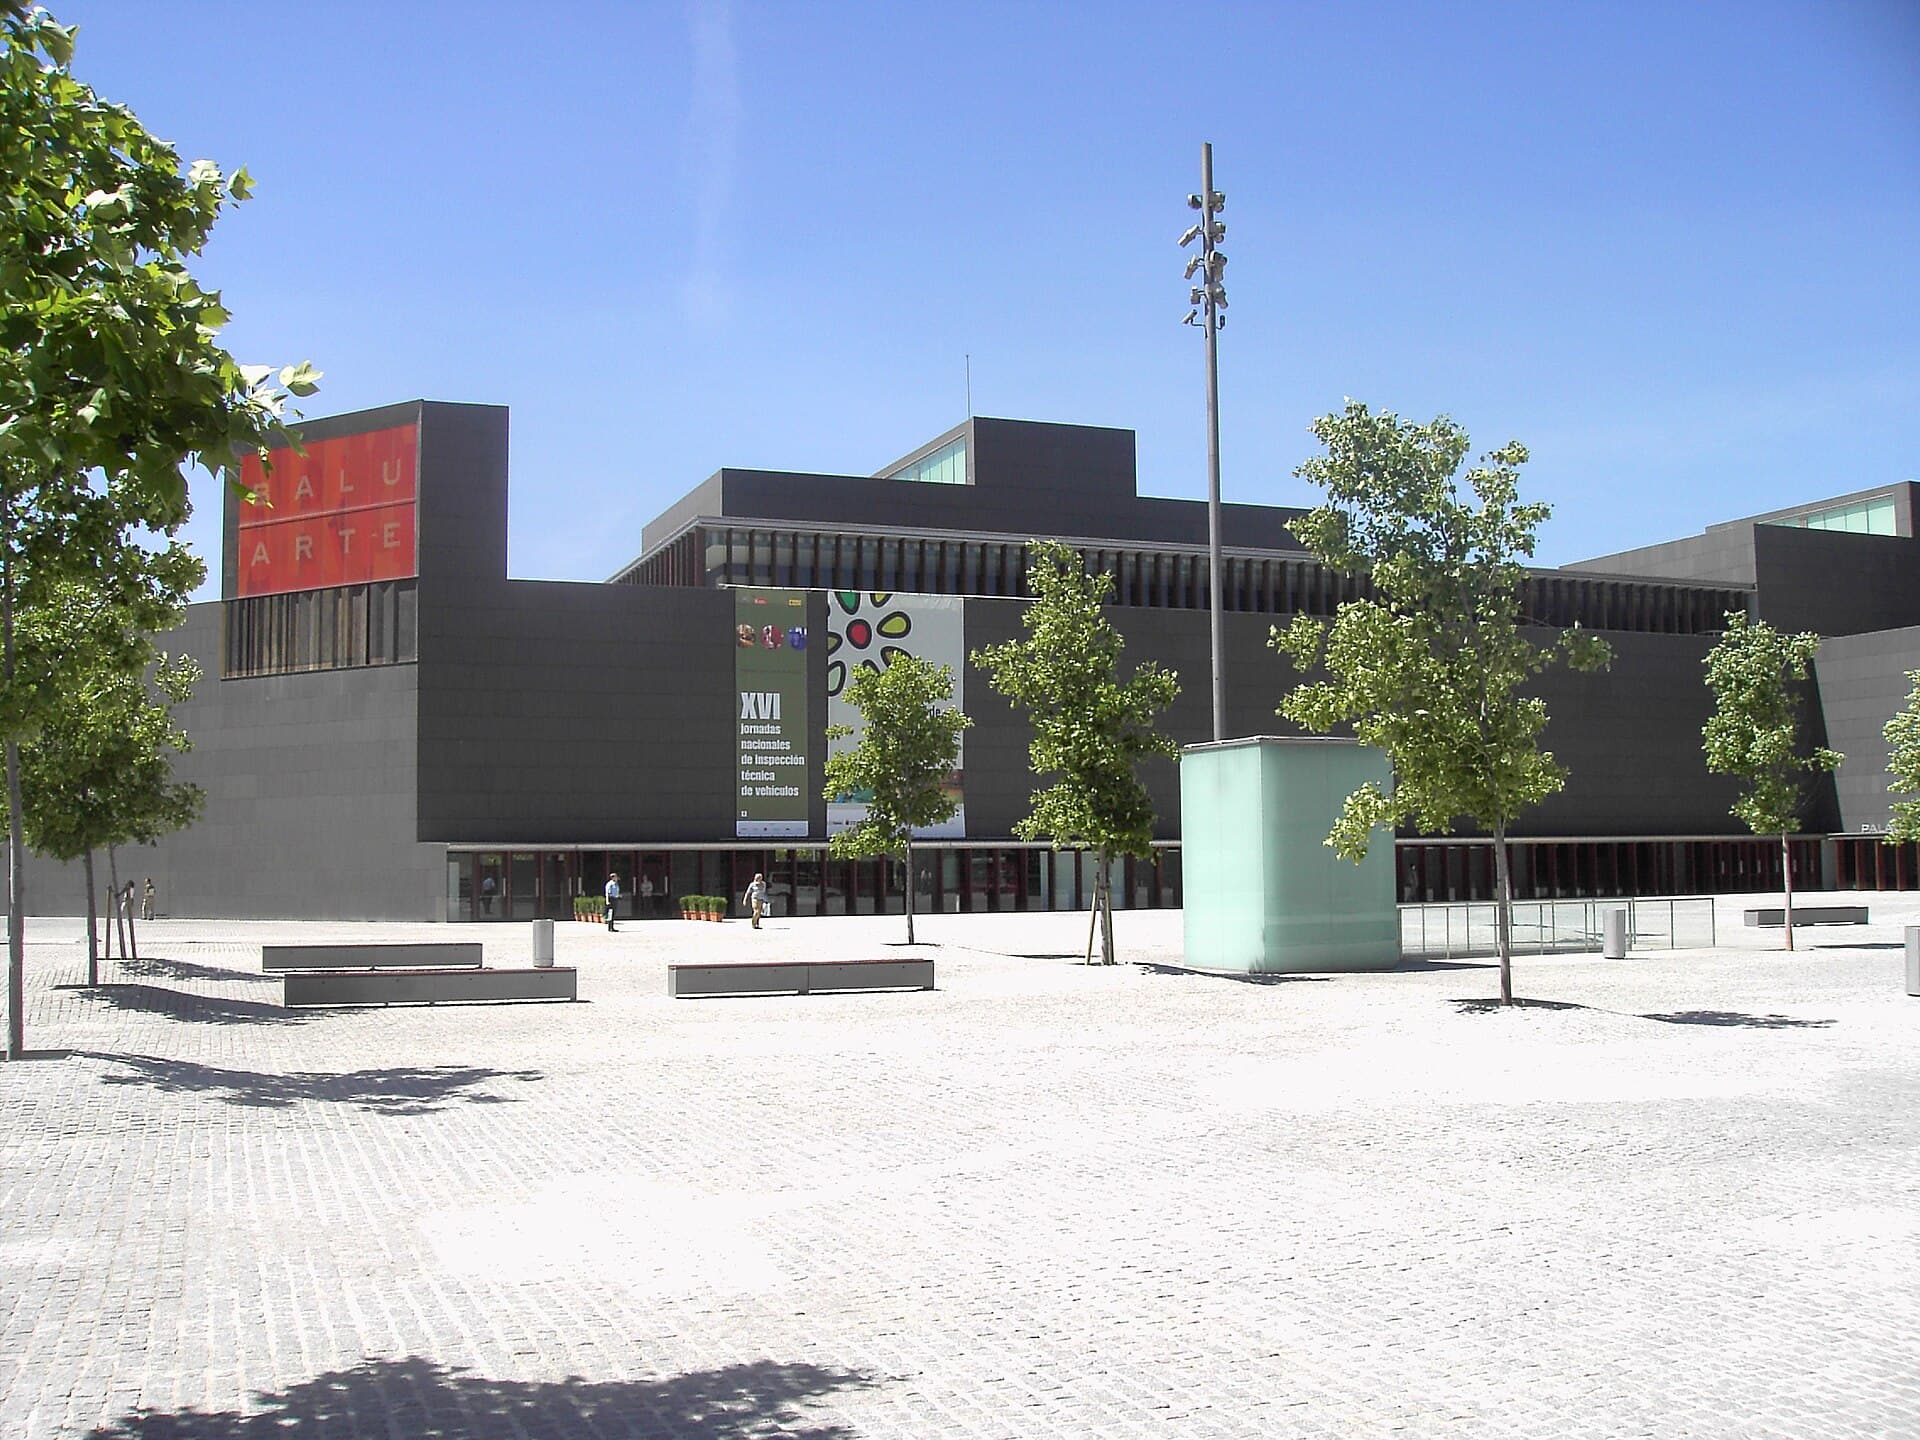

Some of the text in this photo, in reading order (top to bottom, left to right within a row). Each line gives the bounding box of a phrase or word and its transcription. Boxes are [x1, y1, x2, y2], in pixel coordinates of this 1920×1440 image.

[251, 522, 400, 566] ARTE
[741, 692, 780, 719] XVI
[741, 723, 781, 735] jornadas
[741, 739, 791, 750] nacionales
[741, 754, 805, 766] de inspección
[741, 770, 775, 781] técnica
[741, 785, 753, 796] de
